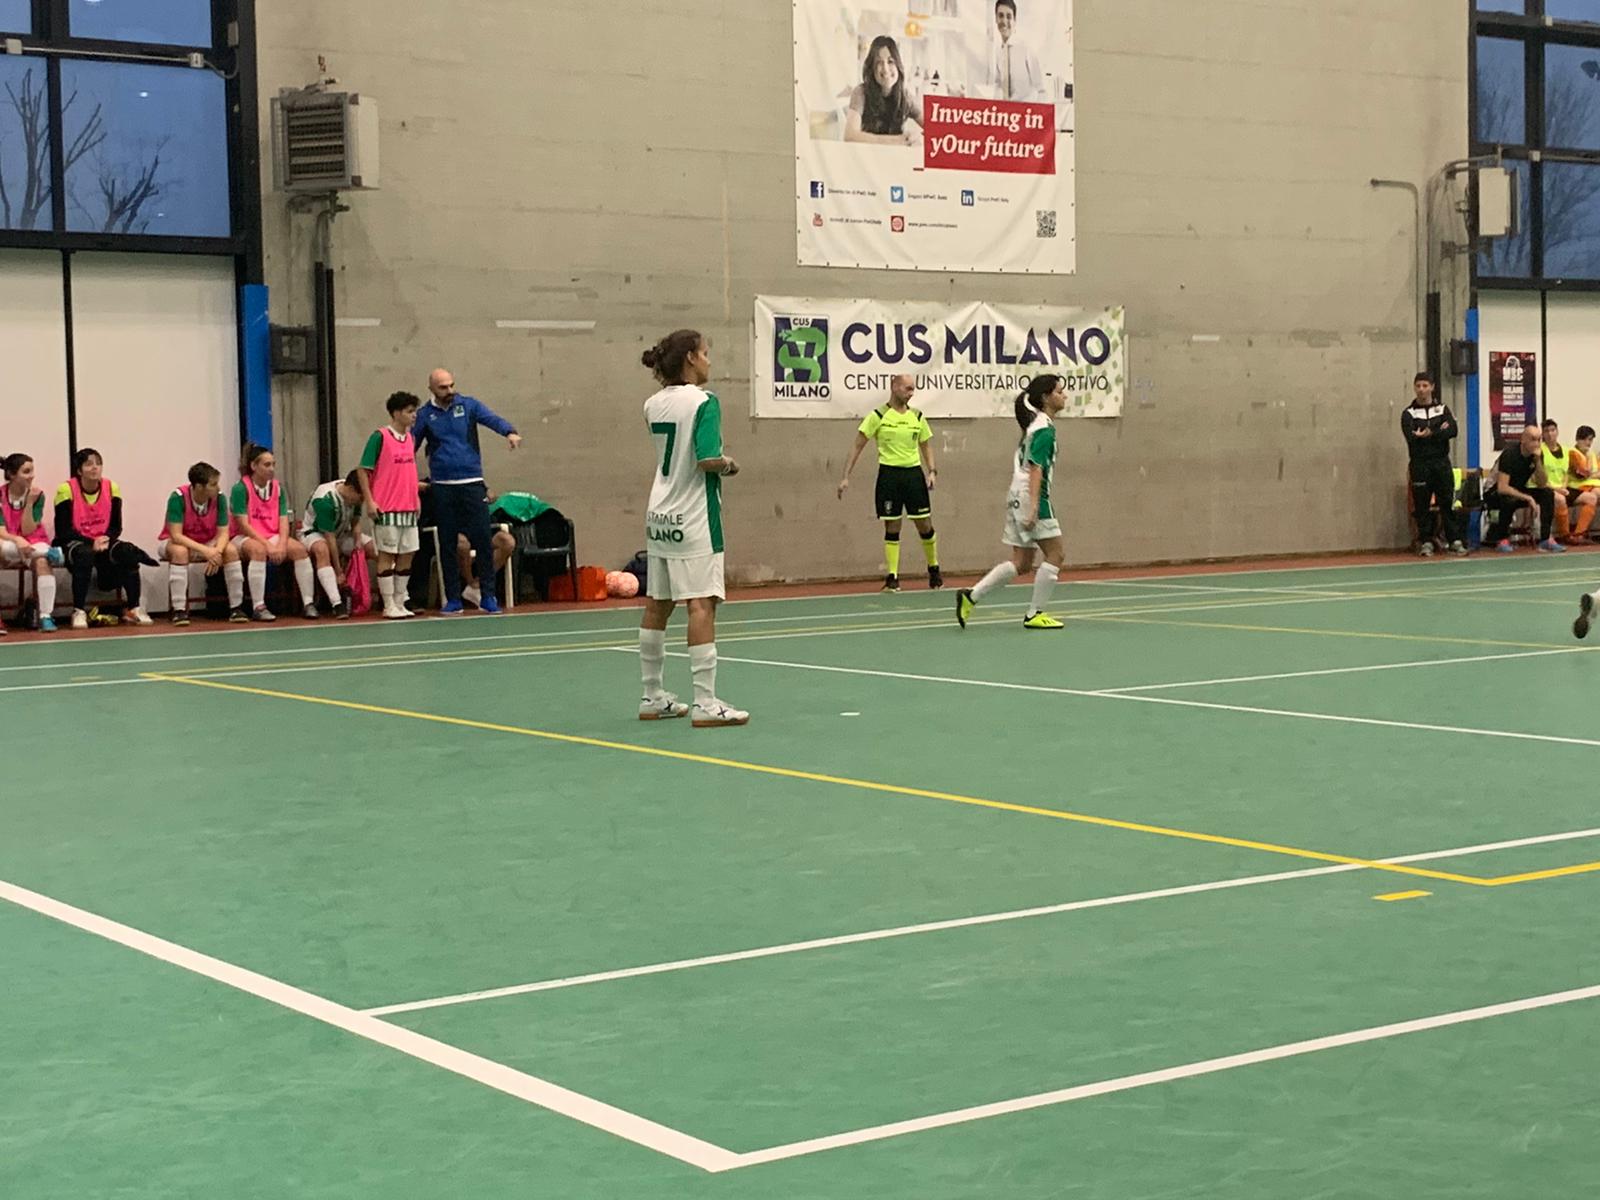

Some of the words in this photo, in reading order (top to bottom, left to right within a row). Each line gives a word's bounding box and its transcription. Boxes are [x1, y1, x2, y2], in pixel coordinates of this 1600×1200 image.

[930, 103, 1021, 133] Investing
[1024, 108, 1045, 129] in
[929, 134, 982, 158] yOur
[981, 137, 1045, 161] future
[792, 317, 810, 326] CUS
[842, 322, 932, 365] CUS
[944, 324, 1111, 366] MILANO
[774, 384, 830, 398] MILANO
[844, 374, 897, 391] CENT
[915, 375, 1031, 391] UNIVERSITARIO
[1058, 375, 1109, 391] ORTIVO
[650, 421, 677, 477] 7
[646, 526, 684, 543] ILANO
